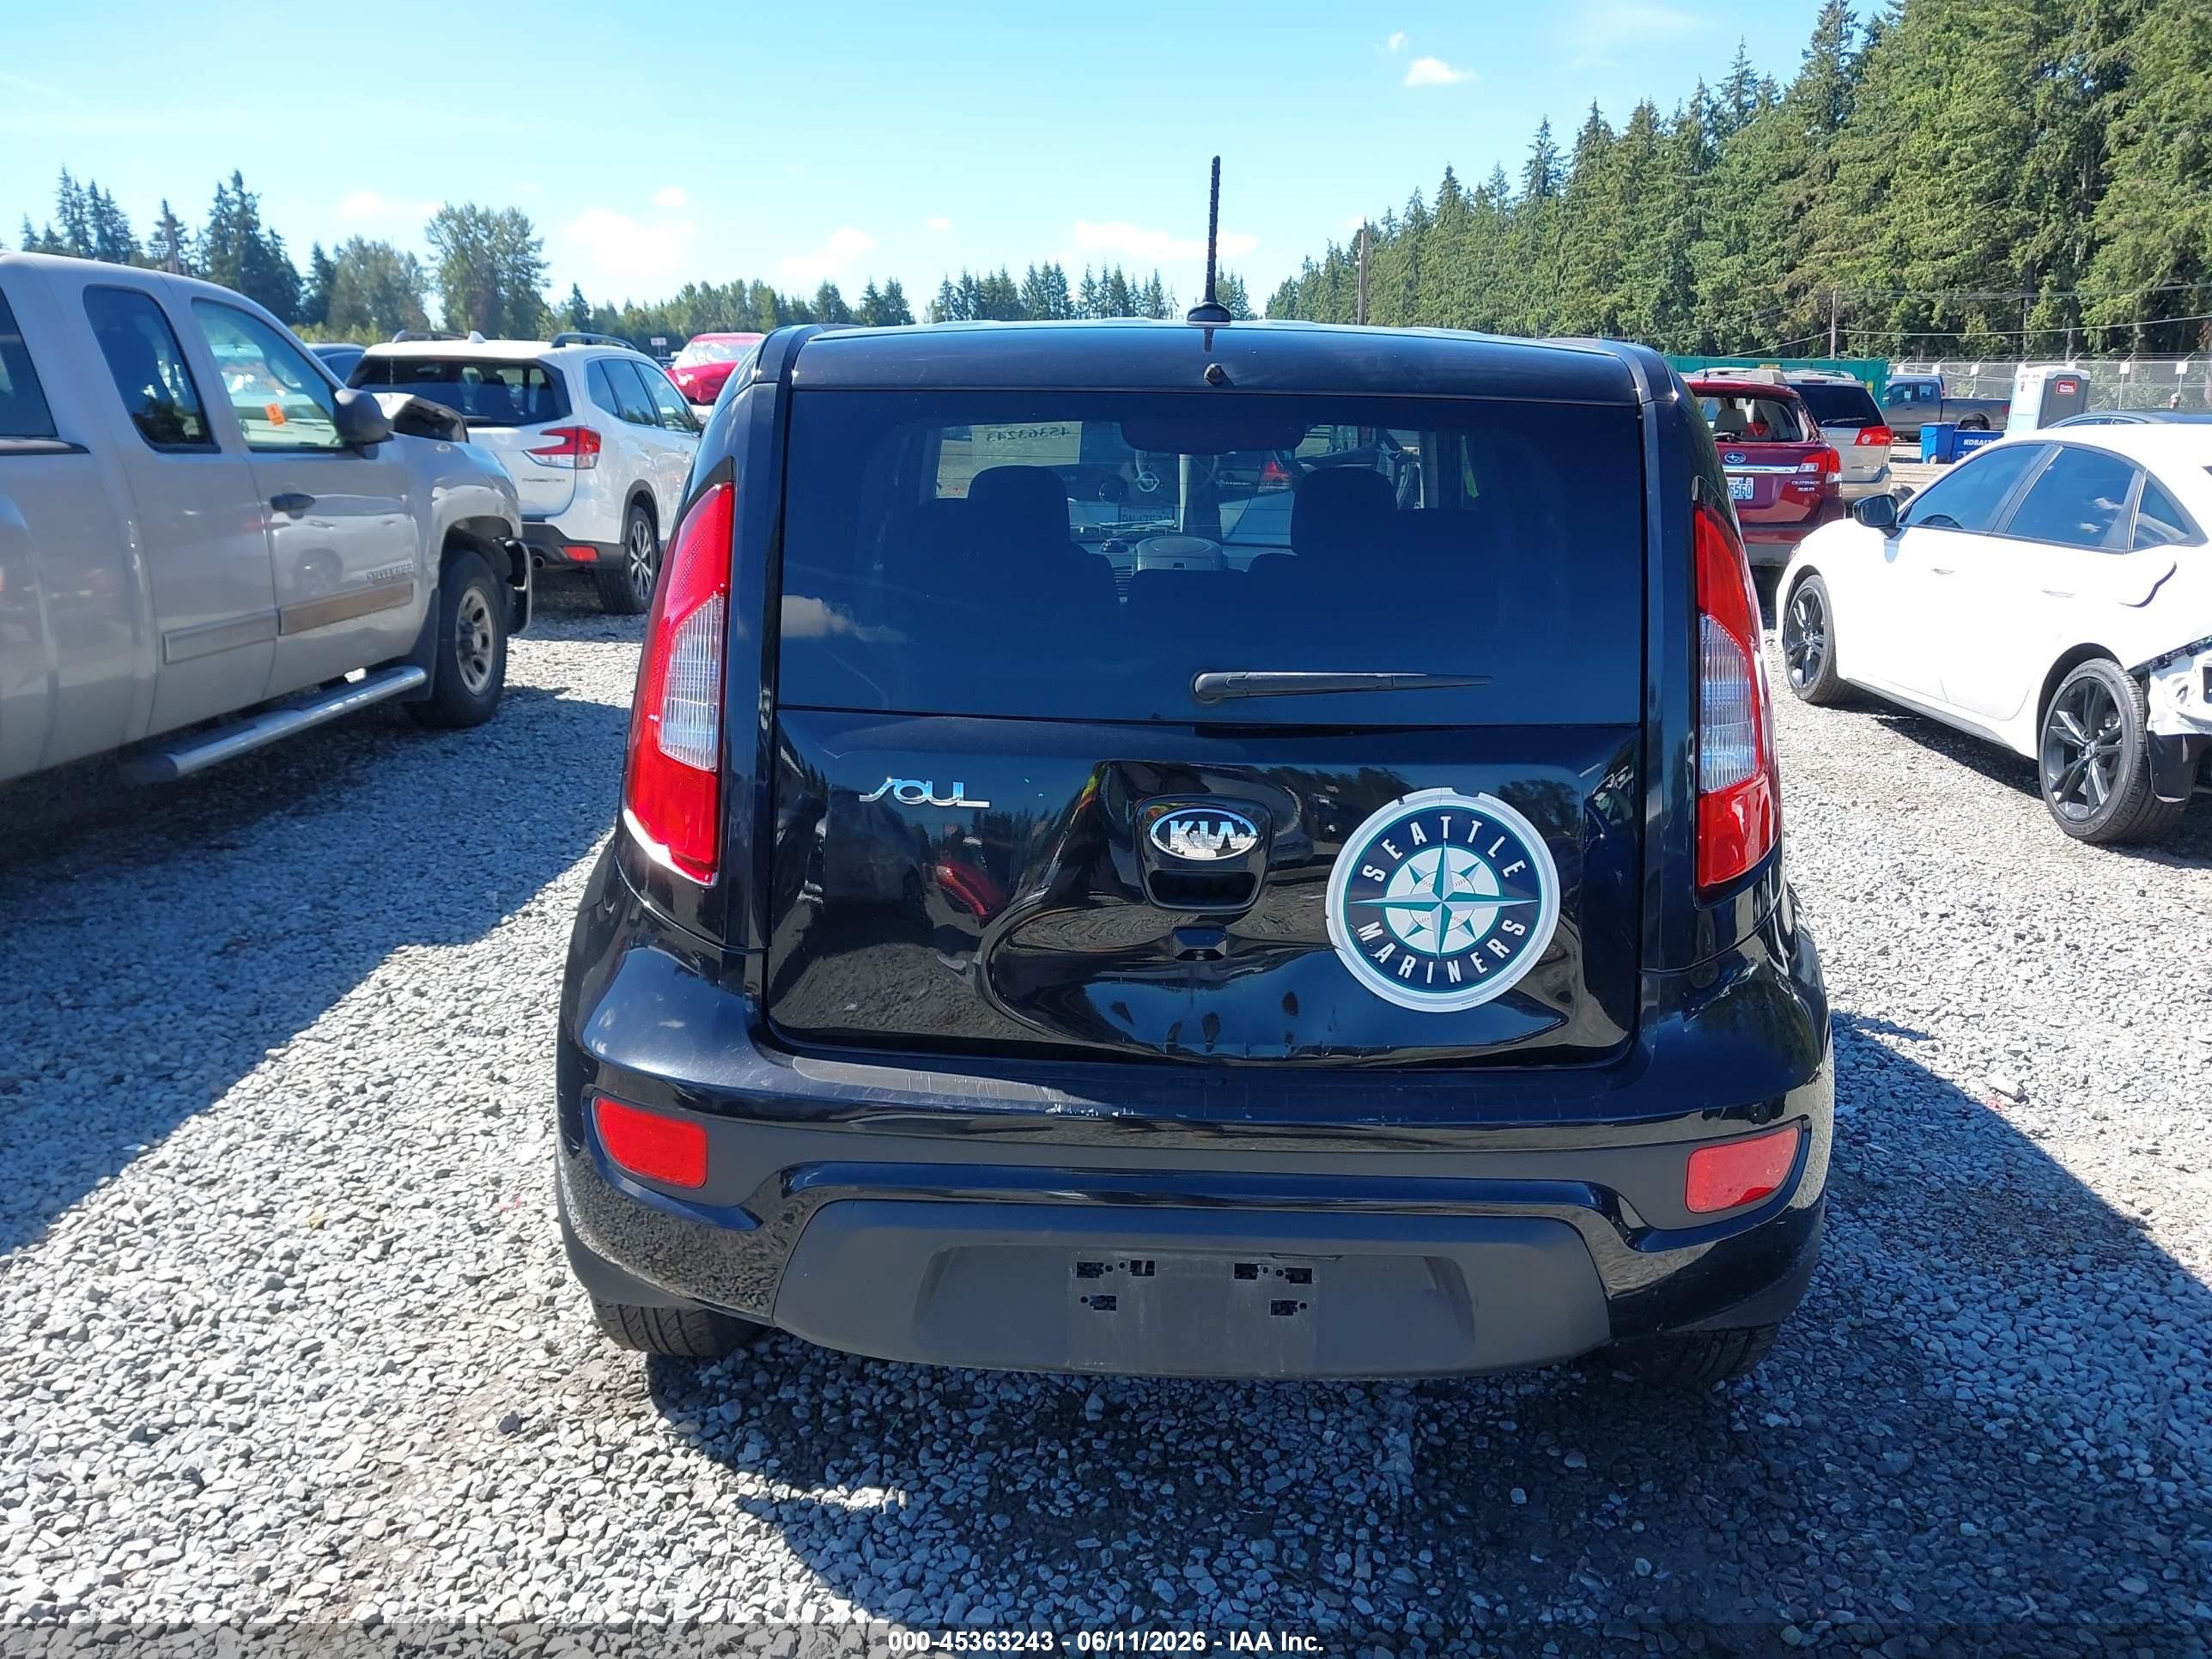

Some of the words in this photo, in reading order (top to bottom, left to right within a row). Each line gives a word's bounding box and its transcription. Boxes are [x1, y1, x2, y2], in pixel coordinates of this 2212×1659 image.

[860, 778, 990, 807] SOUL
[1169, 820, 1238, 849] KIA
[1362, 816, 1527, 882] SEATTLE
[1357, 919, 1526, 983] MARINERS
